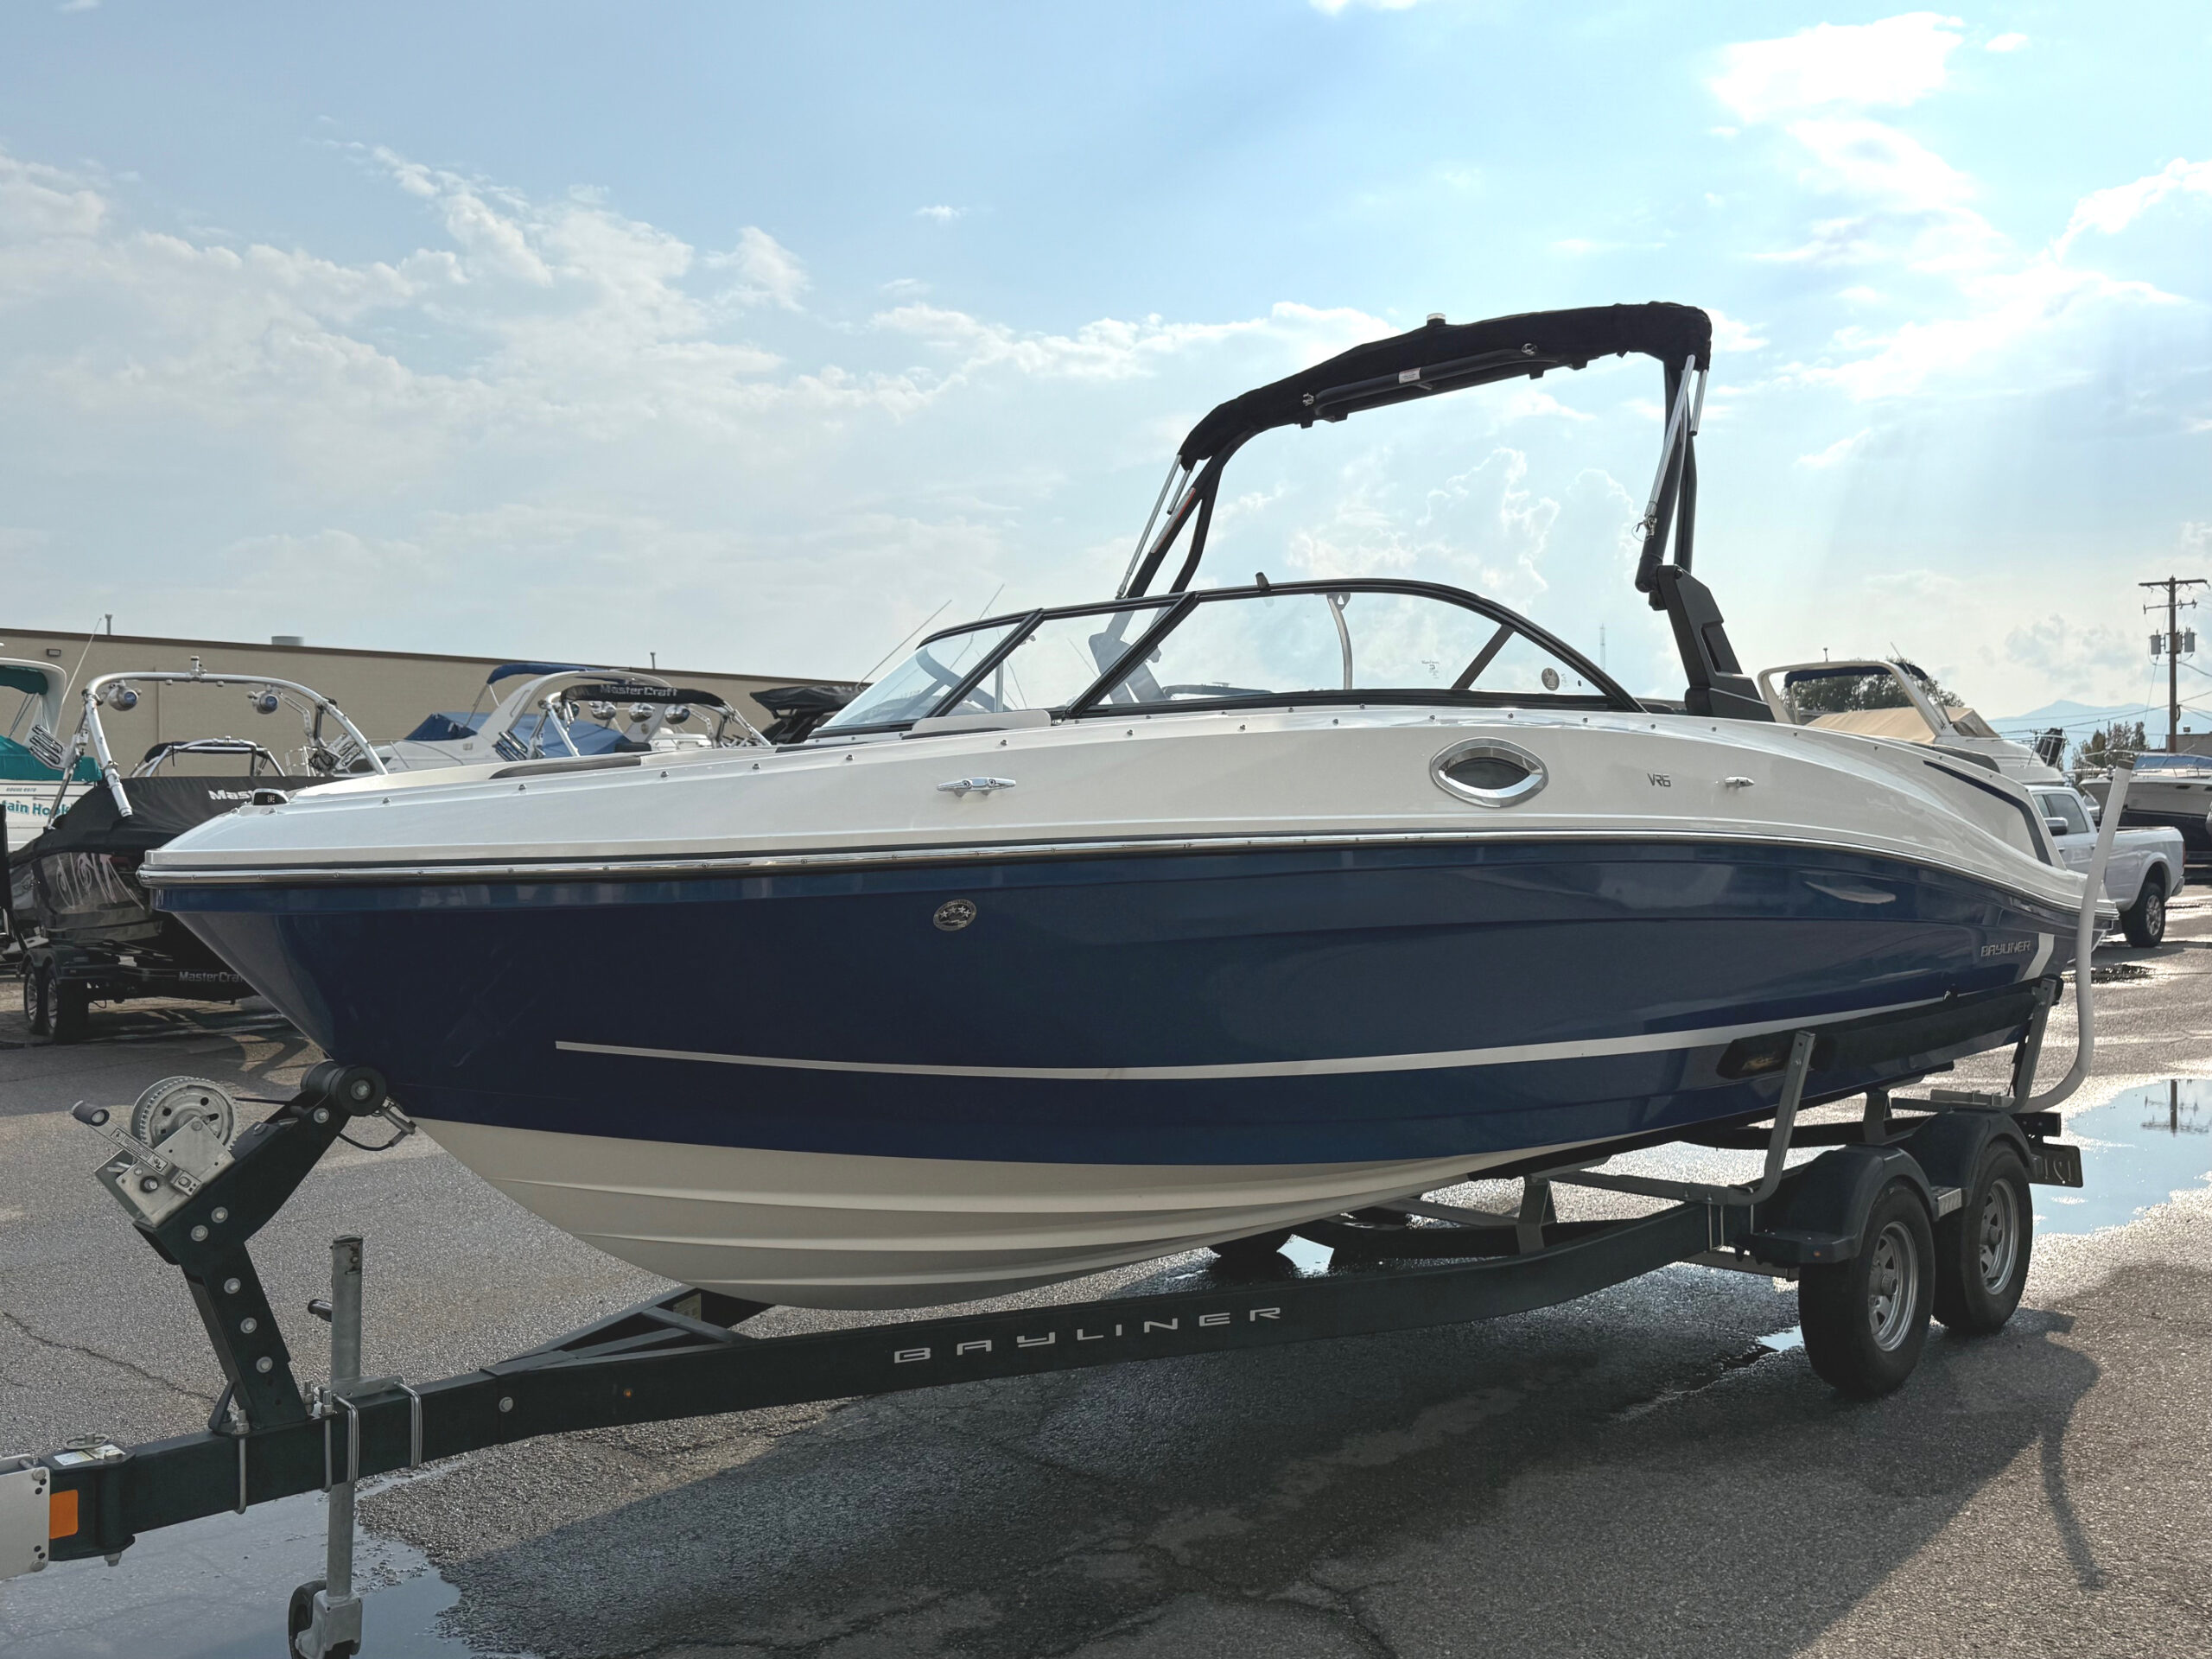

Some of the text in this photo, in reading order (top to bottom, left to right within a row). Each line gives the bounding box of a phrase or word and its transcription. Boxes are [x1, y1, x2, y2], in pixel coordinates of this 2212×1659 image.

[600, 684, 677, 696] MasterCraft
[1647, 773, 1671, 787] VR6
[1980, 940, 2031, 957] BAYLINER
[893, 1306, 1281, 1363] BAYLINER
